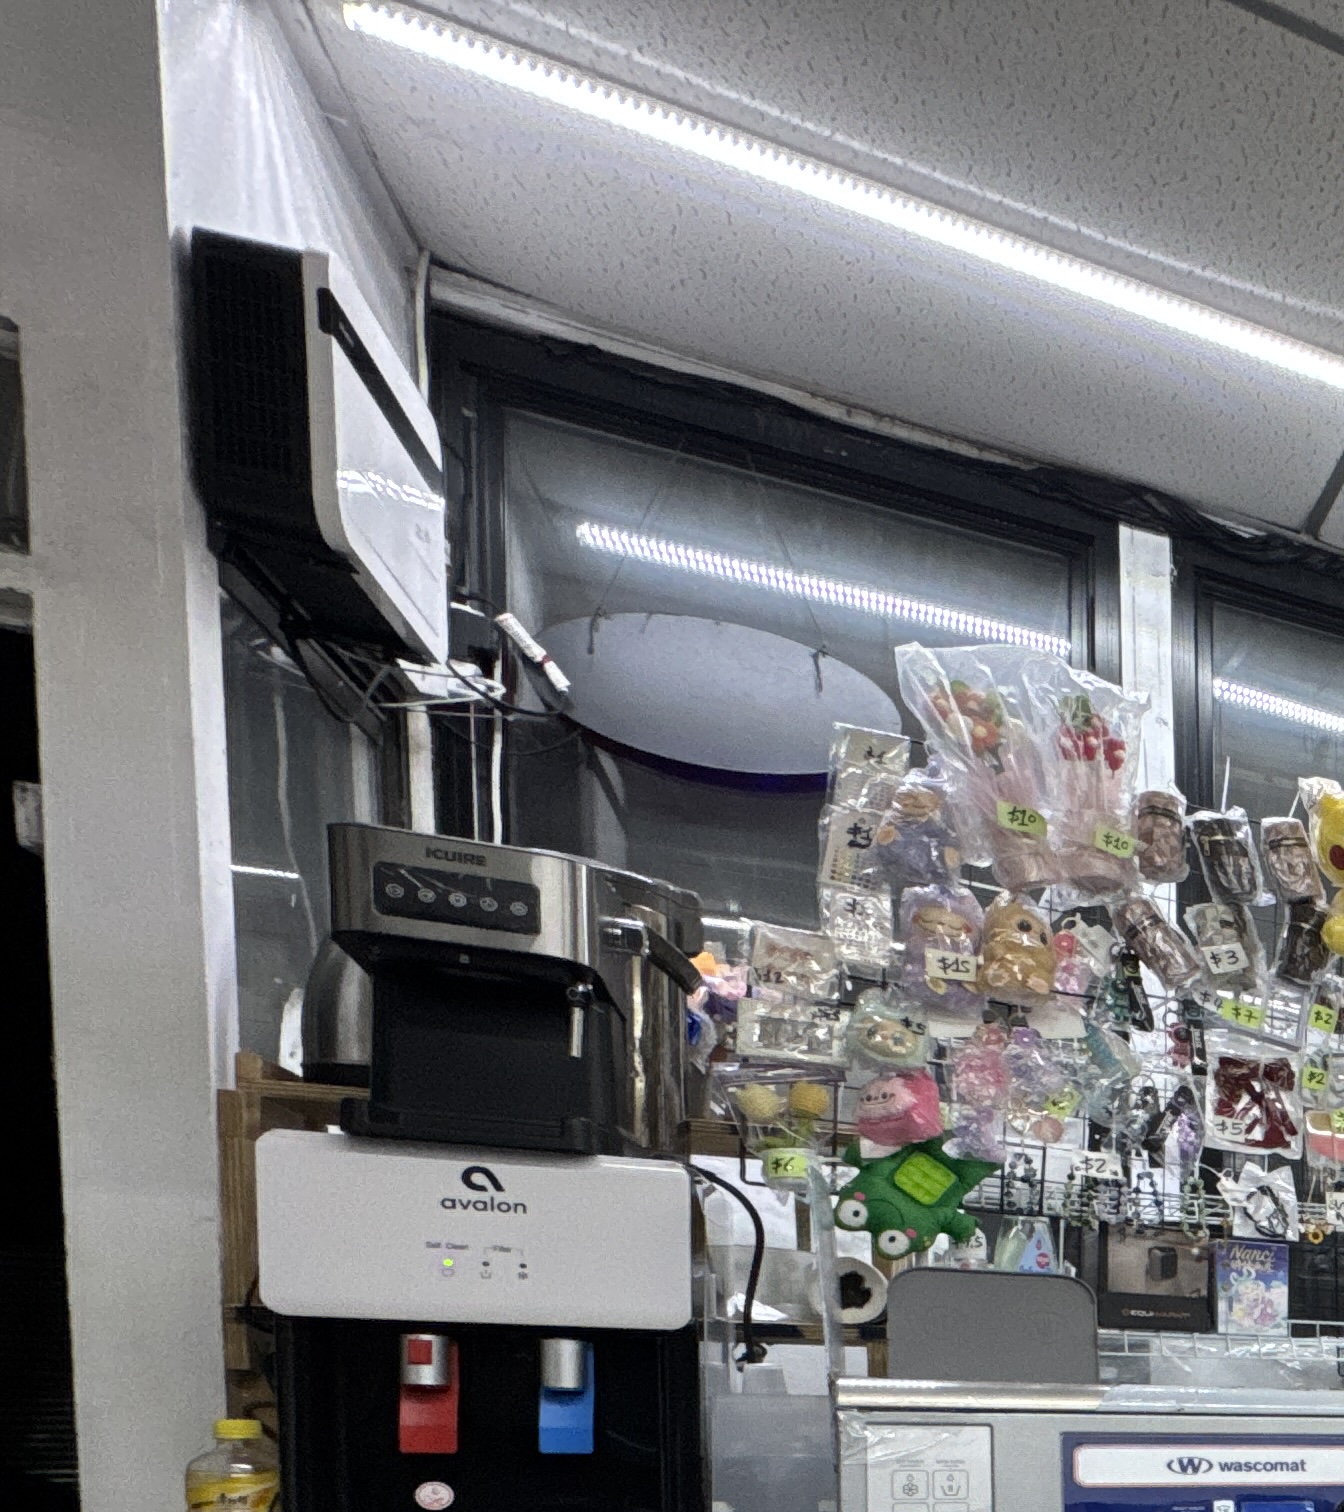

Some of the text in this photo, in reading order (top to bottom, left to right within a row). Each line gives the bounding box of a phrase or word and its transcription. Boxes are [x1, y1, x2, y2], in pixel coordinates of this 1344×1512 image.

[1007, 806, 1037, 826] $10
[1102, 831, 1129, 850] $10
[937, 956, 971, 974] $15
[1209, 950, 1240, 968] $3
[1231, 1006, 1259, 1022] $7
[1313, 1009, 1333, 1025] $2
[1306, 1071, 1326, 1086] $2
[1214, 1121, 1244, 1136] $5
[770, 1156, 794, 1172] $6
[1079, 1156, 1106, 1175] $2
[440, 1195, 528, 1215] avalon
[1218, 1457, 1307, 1474] wascomat
